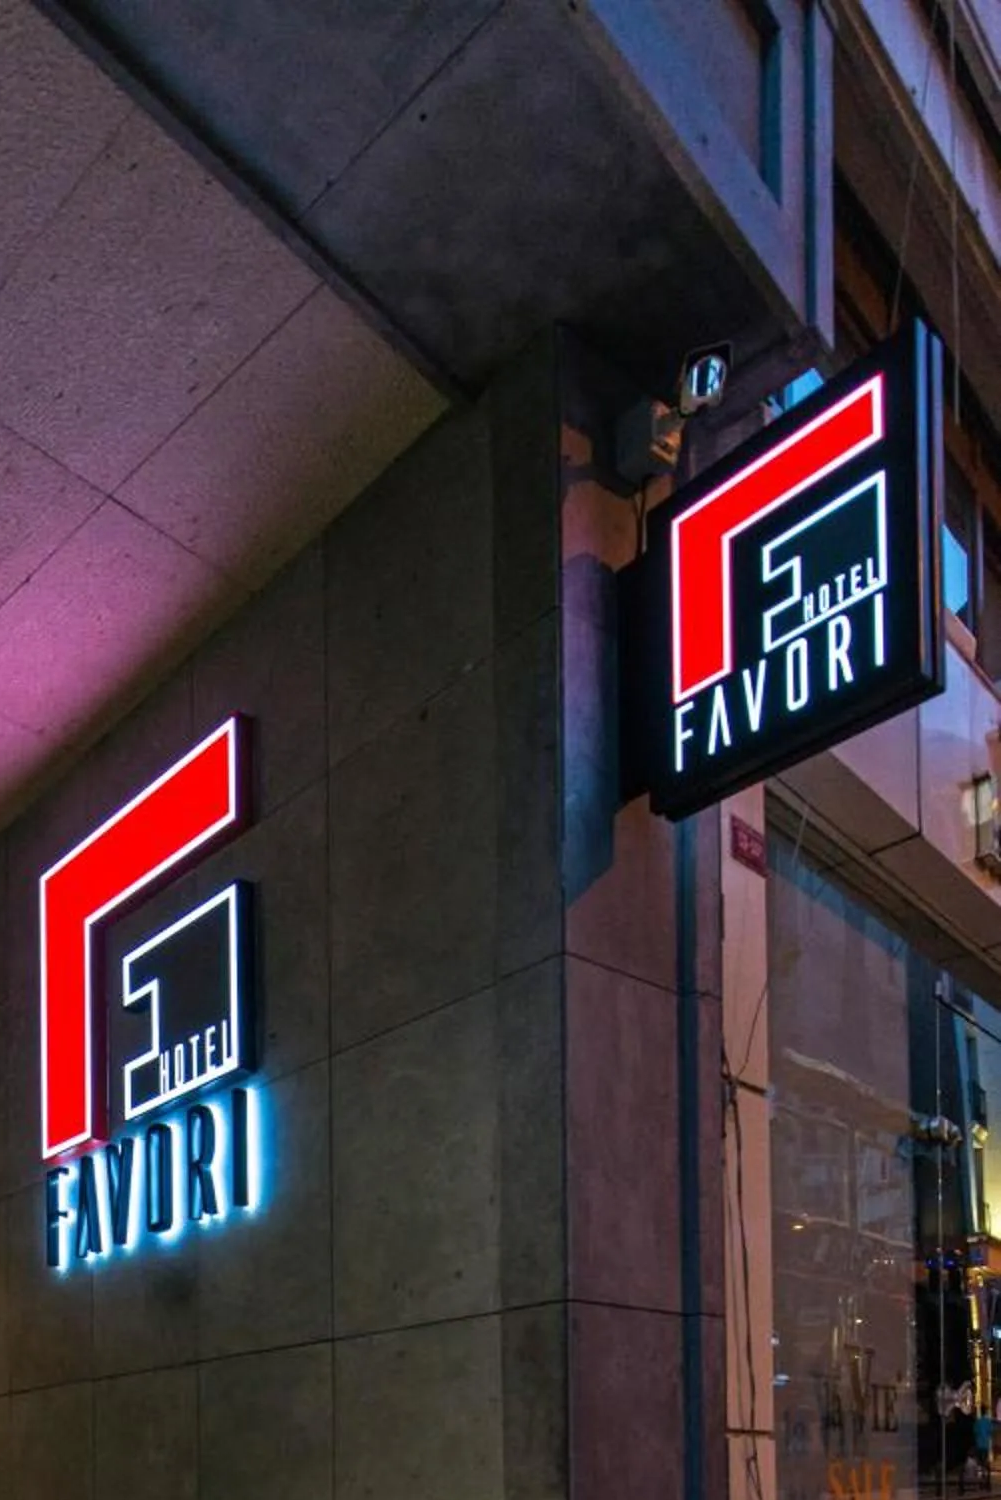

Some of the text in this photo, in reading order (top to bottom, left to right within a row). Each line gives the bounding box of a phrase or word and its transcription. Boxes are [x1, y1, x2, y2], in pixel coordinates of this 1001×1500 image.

[803, 557, 880, 623] HOTEL
[674, 593, 884, 772] FAVORI
[159, 1019, 234, 1096] HOTEL
[46, 1087, 255, 1268] FAVORI
